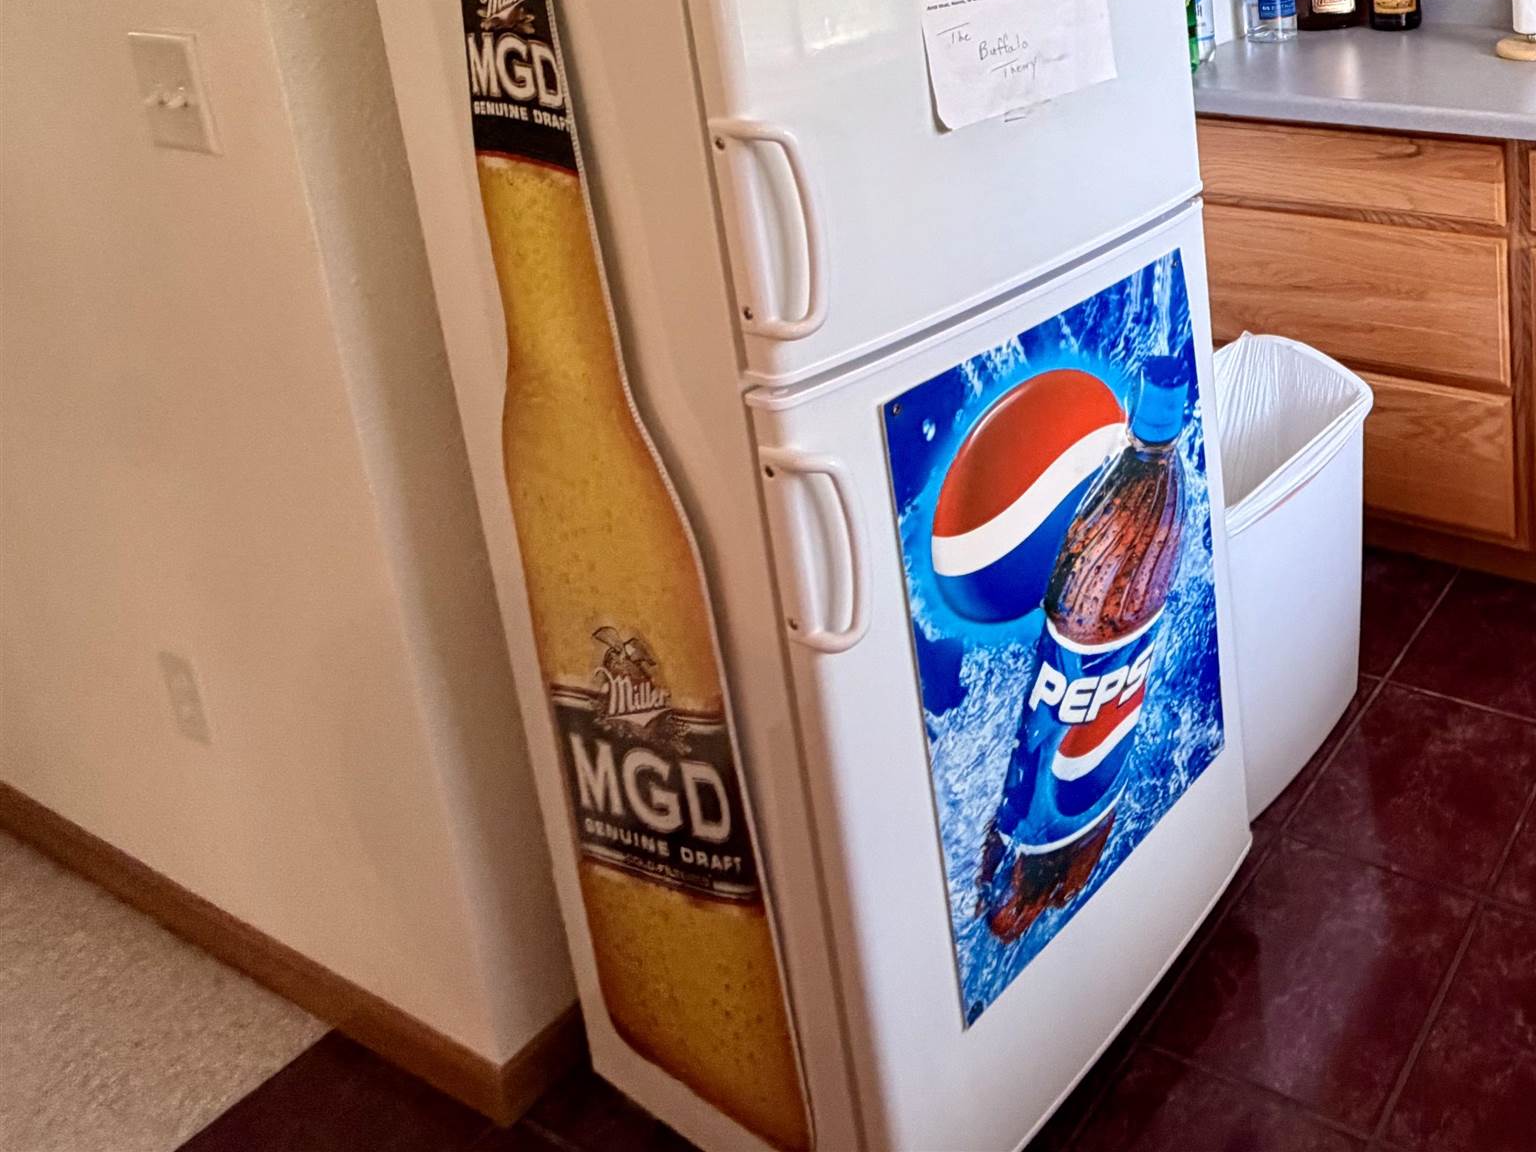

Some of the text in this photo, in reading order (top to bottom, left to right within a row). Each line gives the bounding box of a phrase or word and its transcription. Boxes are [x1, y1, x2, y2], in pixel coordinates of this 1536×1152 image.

[936, 22, 971, 44] The
[978, 33, 1028, 60] Buffalo
[467, 32, 565, 109] MGD
[473, 100, 529, 121] GENUINE
[593, 666, 671, 716] Miller
[569, 732, 732, 843] MGD
[585, 818, 670, 857] GENUINE
[680, 846, 742, 873] DRAFT
